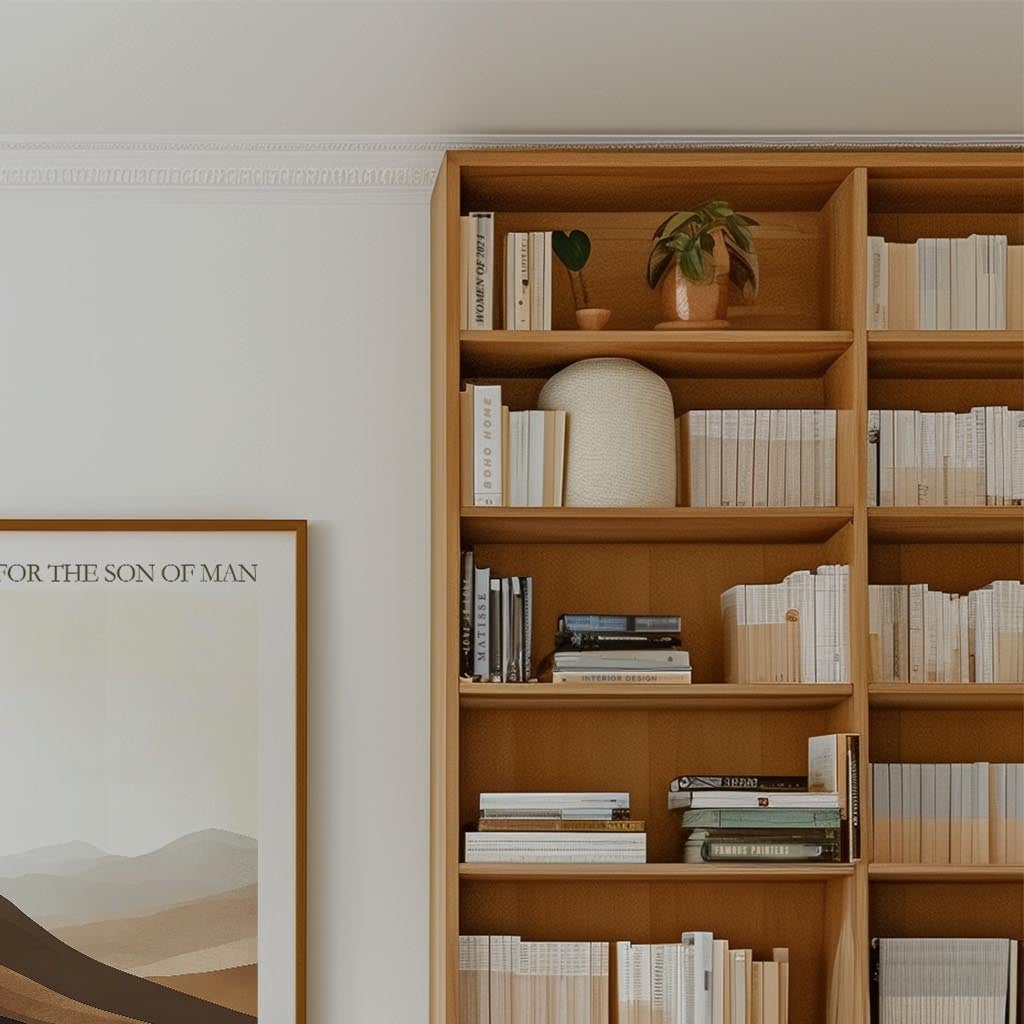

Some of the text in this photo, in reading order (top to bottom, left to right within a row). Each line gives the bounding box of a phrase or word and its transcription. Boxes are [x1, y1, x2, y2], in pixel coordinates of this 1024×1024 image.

[476, 258, 485, 276] OF
[475, 278, 485, 324] WOMEN
[483, 397, 492, 489] BOHO HOME
[47, 563, 99, 583] THE
[103, 563, 156, 583] SON
[161, 563, 195, 583] OF
[199, 563, 258, 583] MAN
[477, 592, 486, 662] MATISSE
[714, 845, 789, 856] FAMOUS PAINTERS
